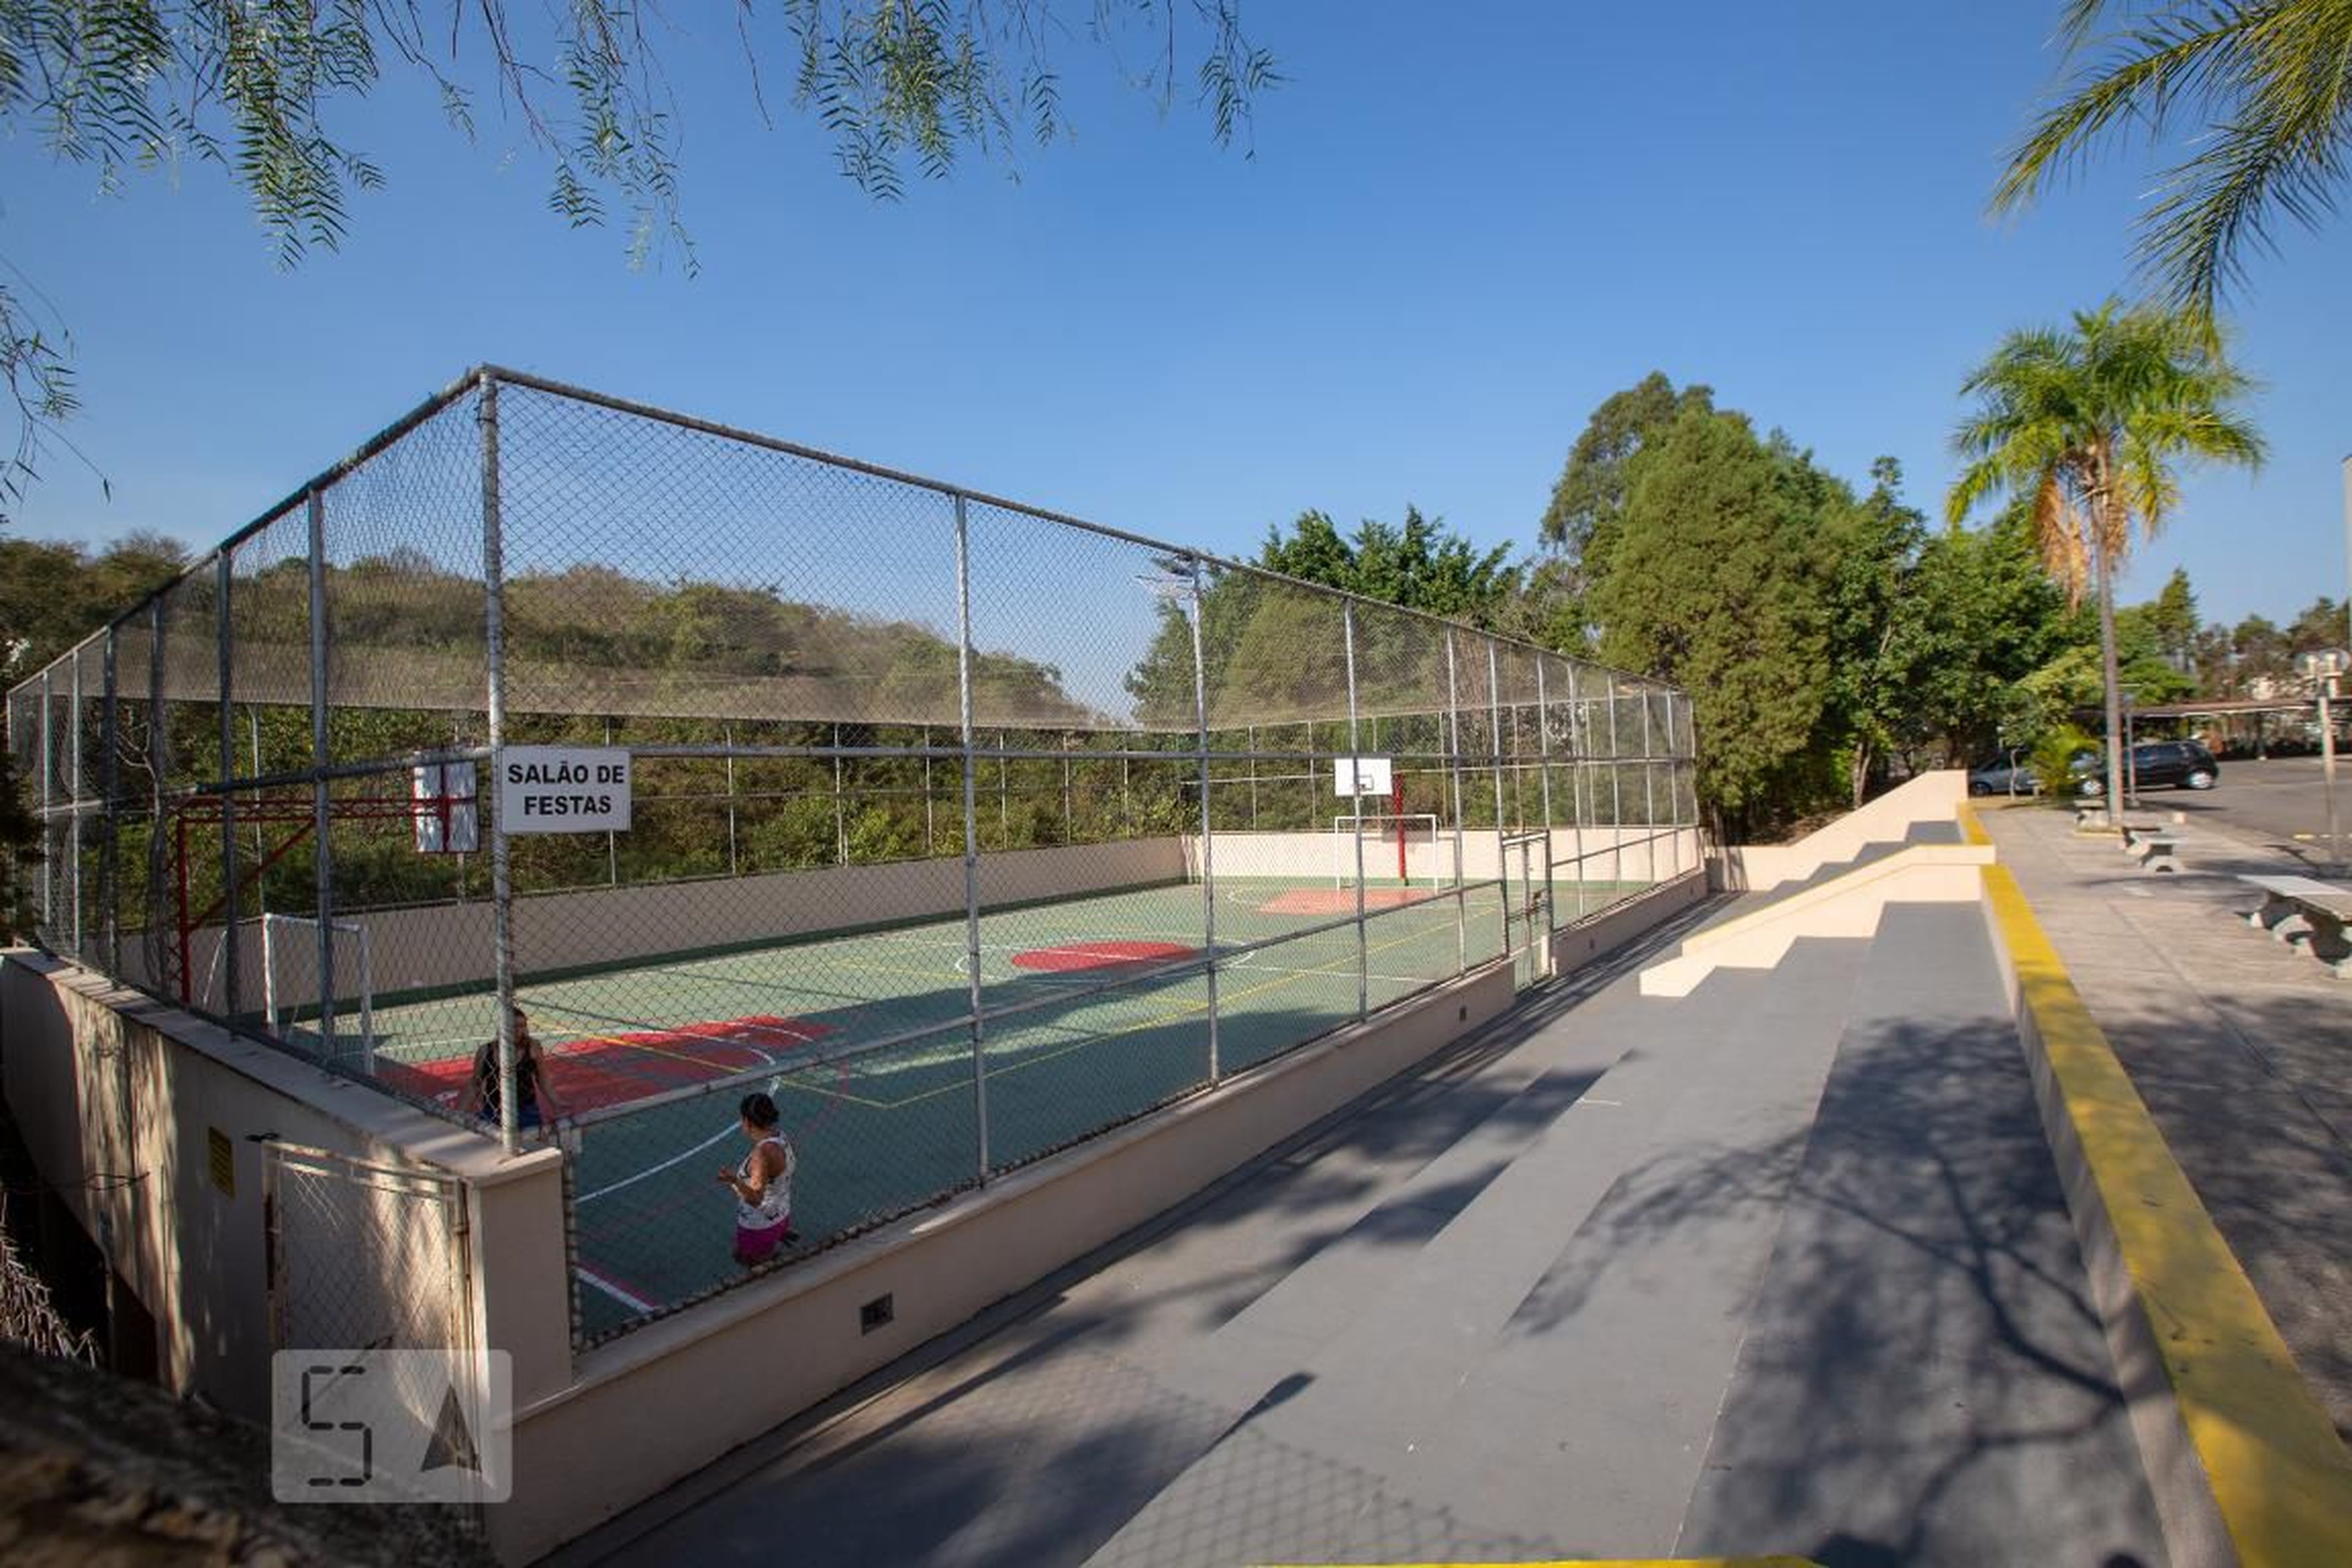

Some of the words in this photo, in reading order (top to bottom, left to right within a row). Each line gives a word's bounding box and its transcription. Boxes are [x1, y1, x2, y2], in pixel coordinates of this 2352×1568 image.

[508, 761, 589, 784] SALÃO
[598, 765, 625, 784] DE
[524, 796, 611, 815] FESTAS
